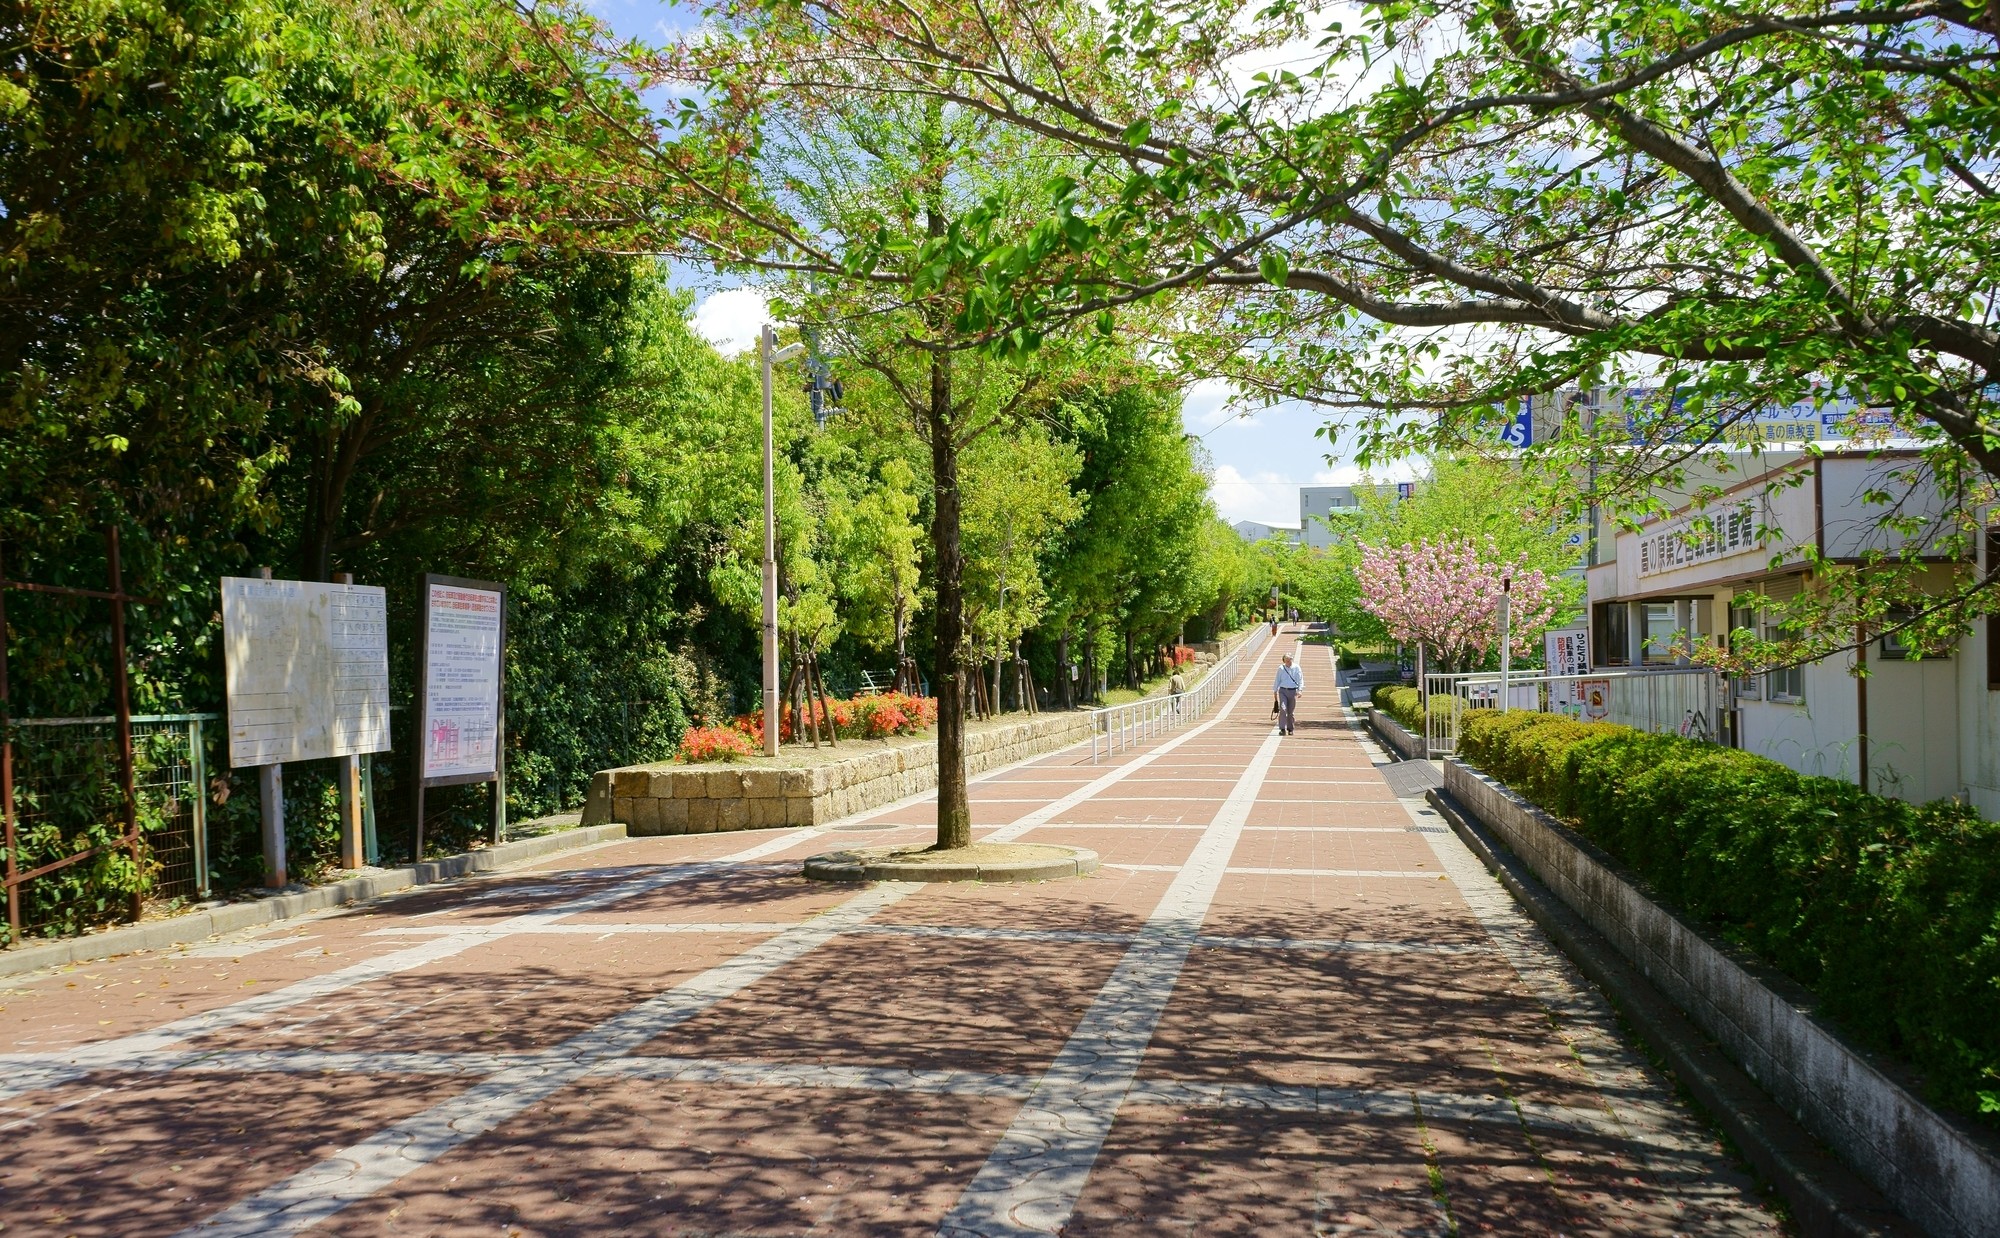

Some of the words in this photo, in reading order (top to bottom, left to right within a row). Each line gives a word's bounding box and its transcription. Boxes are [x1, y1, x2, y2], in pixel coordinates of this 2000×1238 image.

[1766, 424, 1815, 440] 高の原教室
